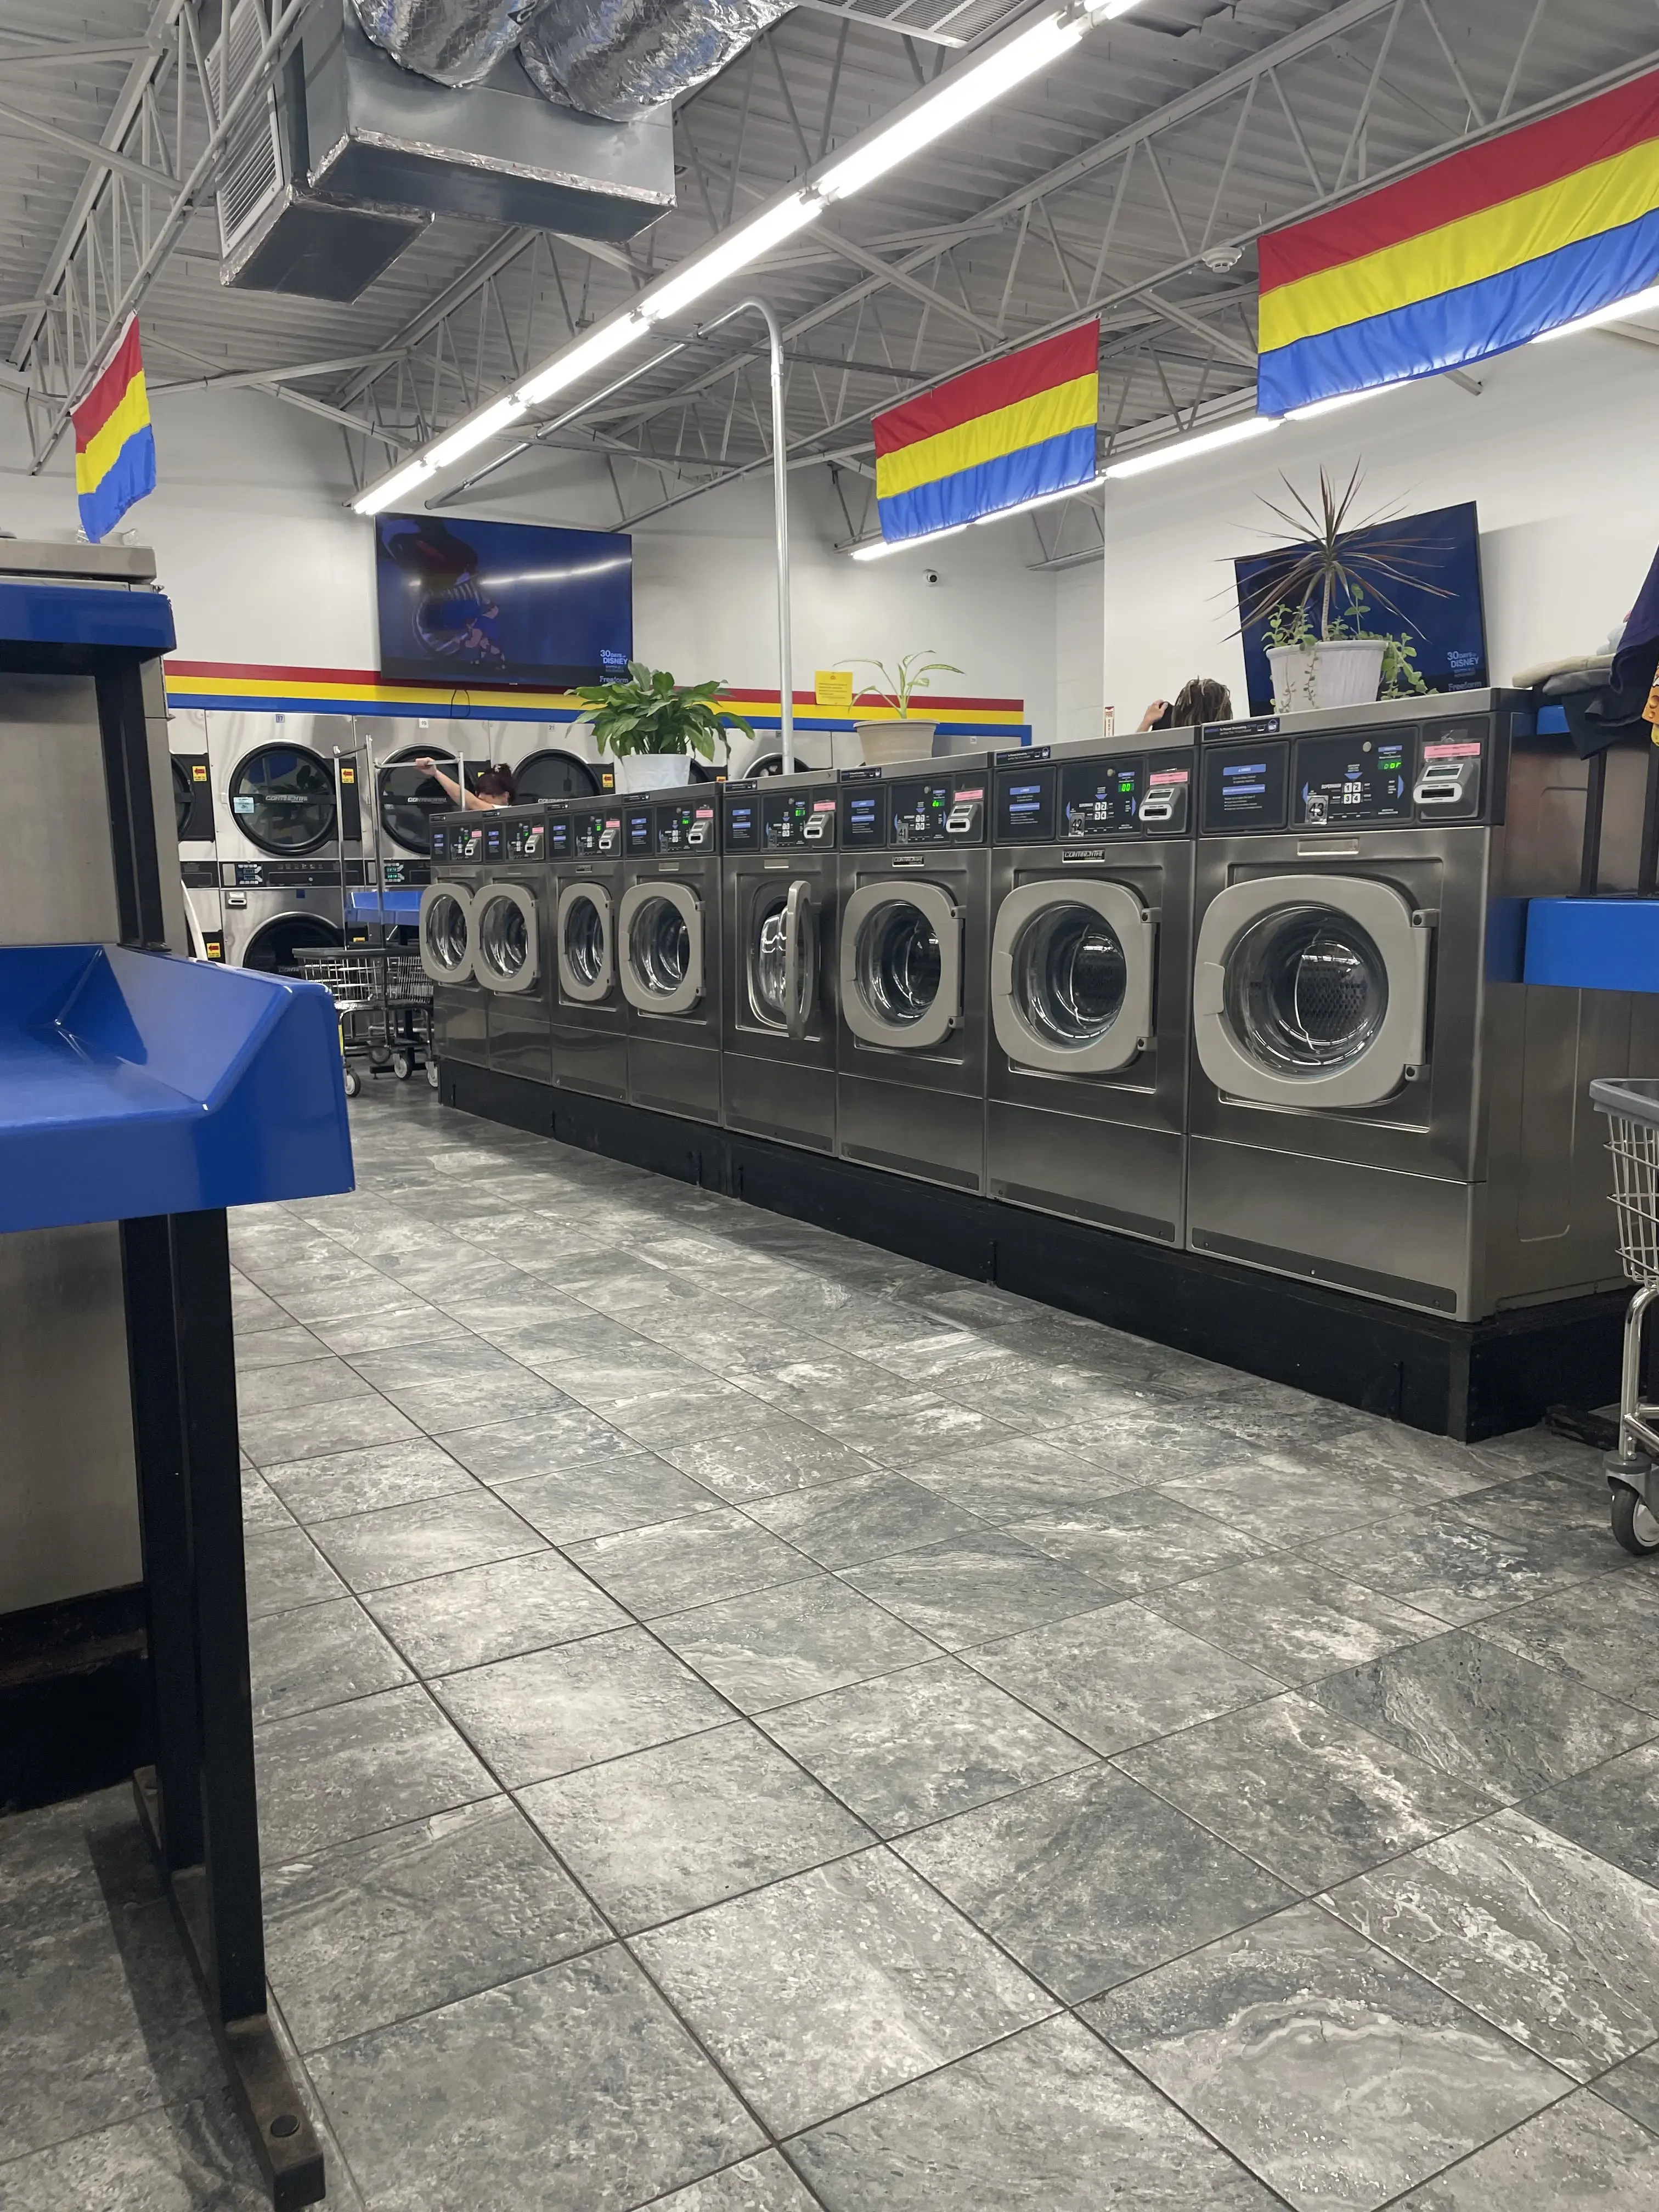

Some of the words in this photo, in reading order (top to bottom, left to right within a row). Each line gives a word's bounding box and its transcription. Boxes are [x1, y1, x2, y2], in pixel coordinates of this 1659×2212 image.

[1447, 651, 1459, 661] 30
[1451, 657, 1479, 668] DISNEY
[1448, 681, 1482, 691] Freeform
[1309, 803, 1324, 817] 43
[1072, 819, 1082, 831] 42
